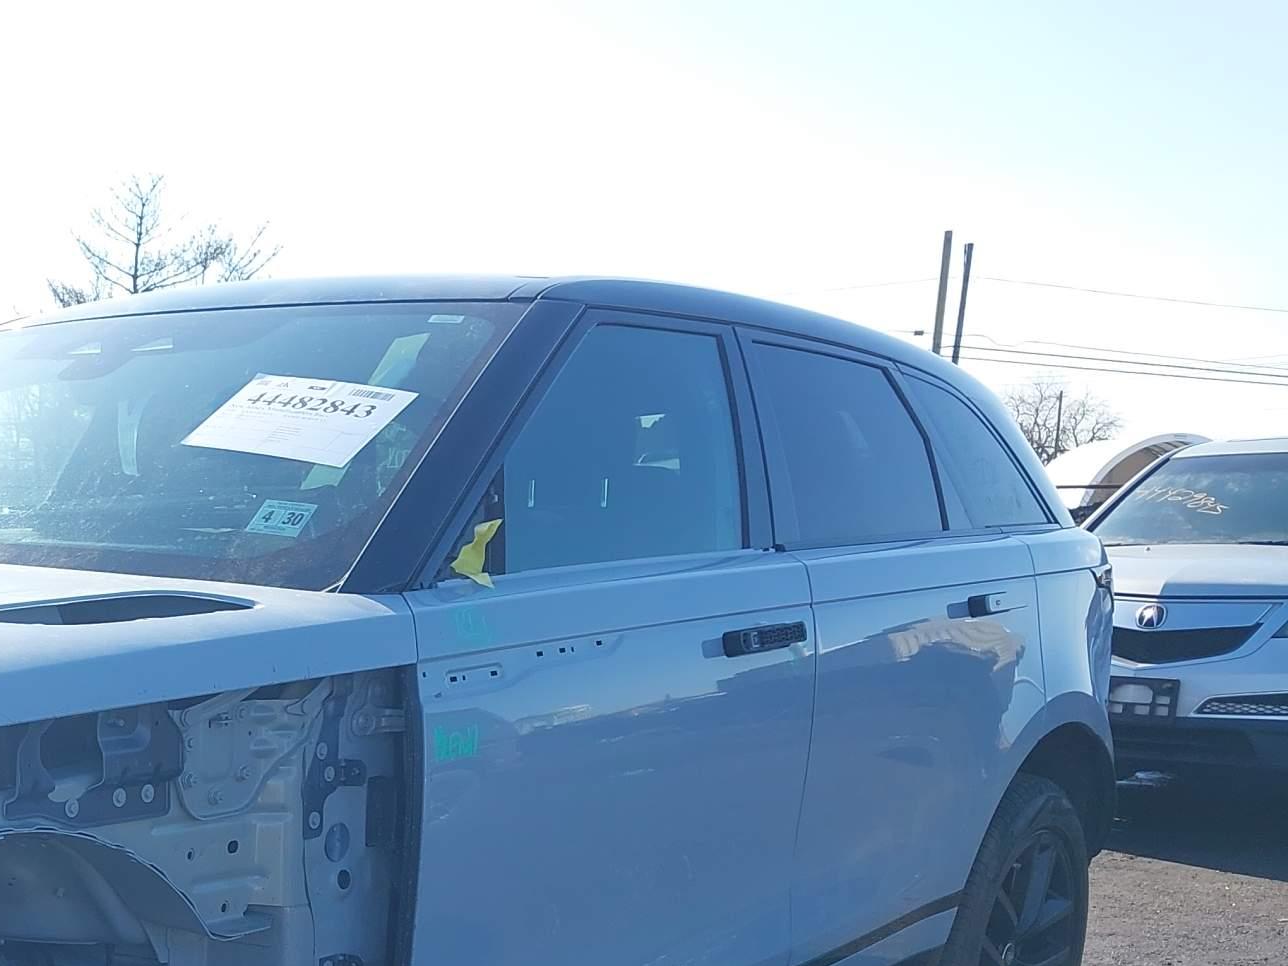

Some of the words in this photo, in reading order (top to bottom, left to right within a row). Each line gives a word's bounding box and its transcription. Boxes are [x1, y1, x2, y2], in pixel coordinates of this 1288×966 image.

[247, 391, 377, 419] 44482843
[261, 510, 276, 524] 4
[282, 511, 305, 526] 30
